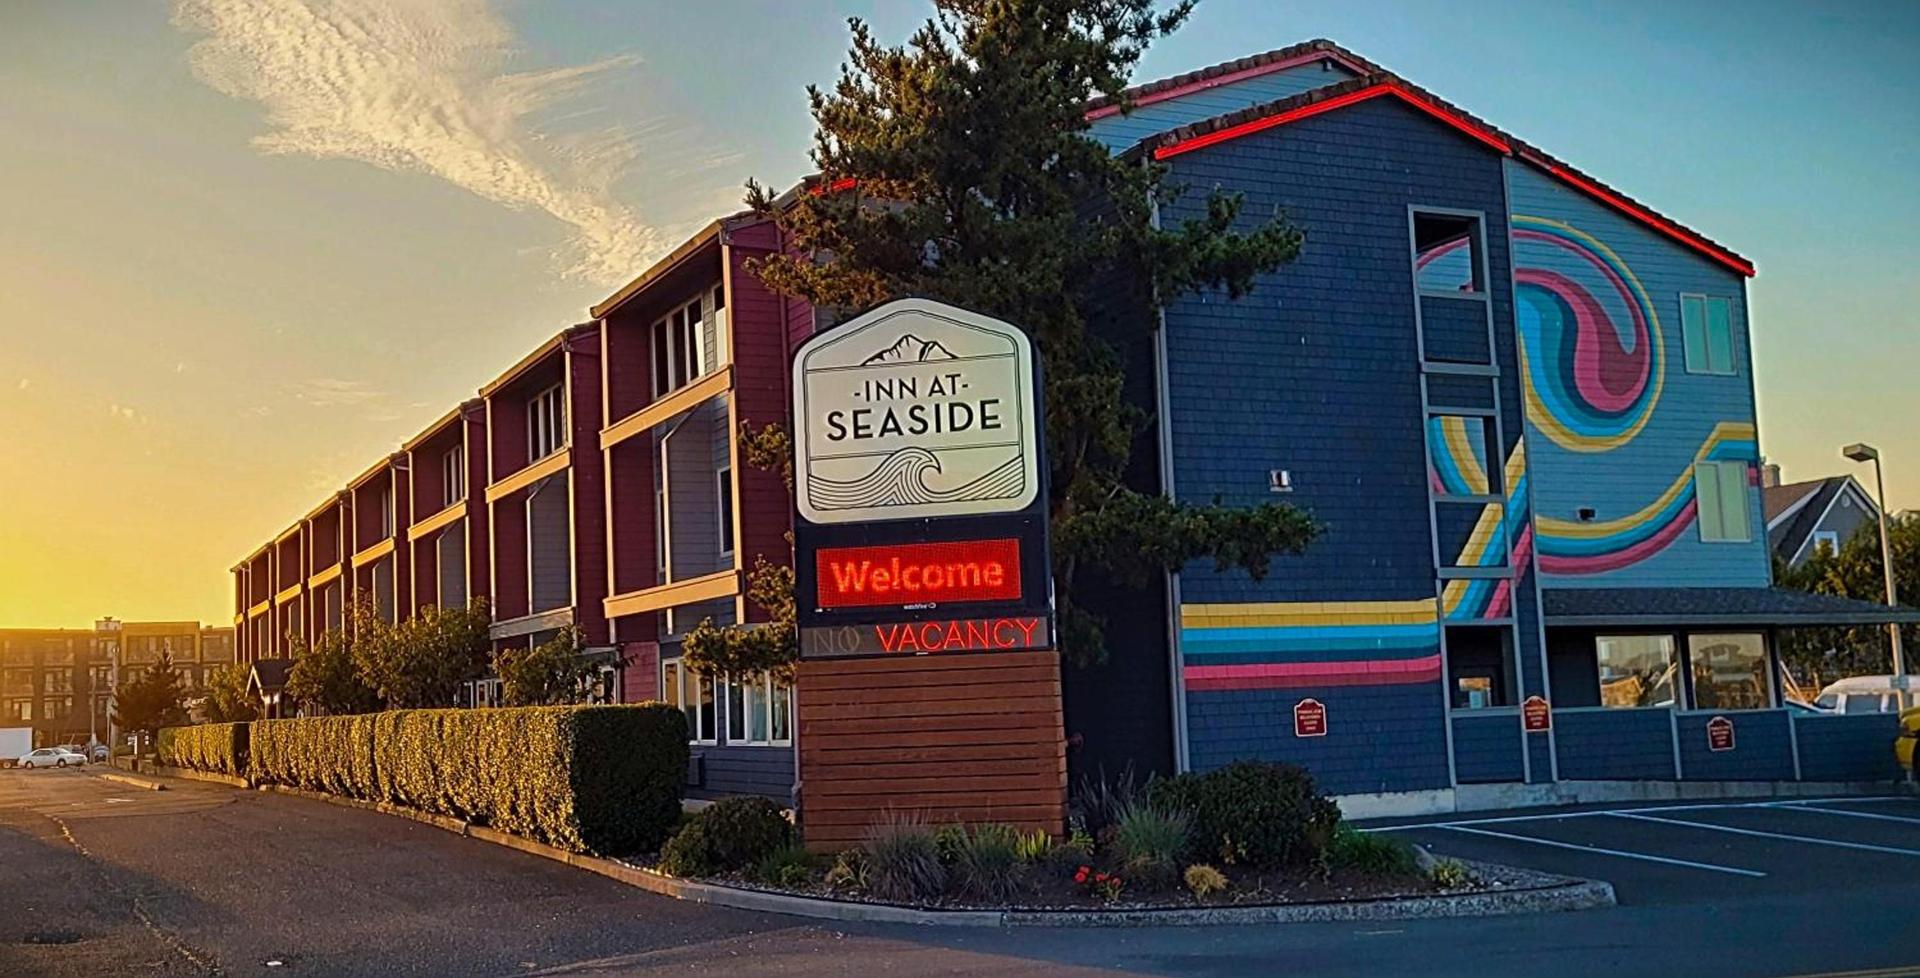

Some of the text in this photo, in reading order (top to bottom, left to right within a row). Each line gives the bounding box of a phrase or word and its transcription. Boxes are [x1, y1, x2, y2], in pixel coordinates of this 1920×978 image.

[827, 399, 1002, 441] SEASIDE
[831, 558, 1004, 592] Welcome
[813, 618, 1038, 653] NO VACANCY
